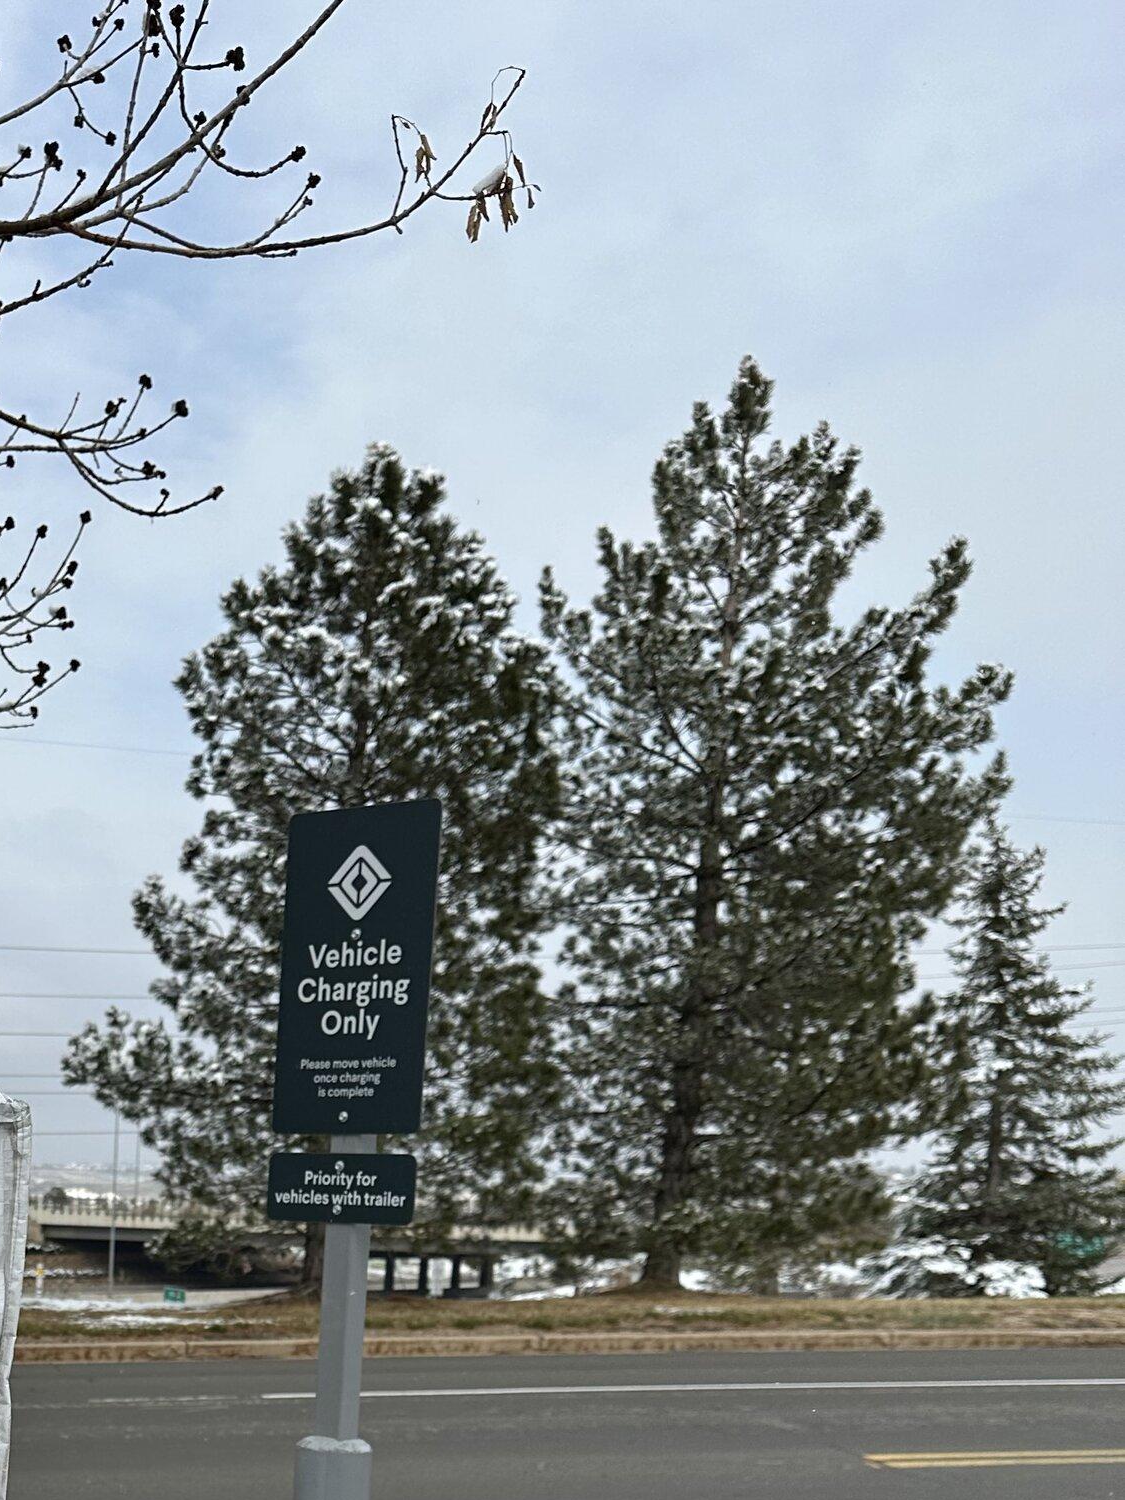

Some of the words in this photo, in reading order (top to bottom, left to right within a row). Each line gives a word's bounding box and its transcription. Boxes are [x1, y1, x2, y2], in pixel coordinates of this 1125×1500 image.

[308, 938, 402, 969] Vehicle
[297, 973, 411, 1007] Charging
[321, 1008, 380, 1041] Only
[300, 1058, 331, 1070] Please
[332, 1058, 359, 1070] move
[361, 1056, 397, 1069] vehicle
[313, 1073, 338, 1084] once
[339, 1072, 381, 1084] charging
[317, 1087, 327, 1097] is
[327, 1086, 374, 1099] complete
[304, 1170, 355, 1190] Priority
[356, 1171, 377, 1187] for
[275, 1189, 329, 1205] vehicles
[331, 1191, 361, 1206] with
[363, 1191, 406, 1207] trailer
